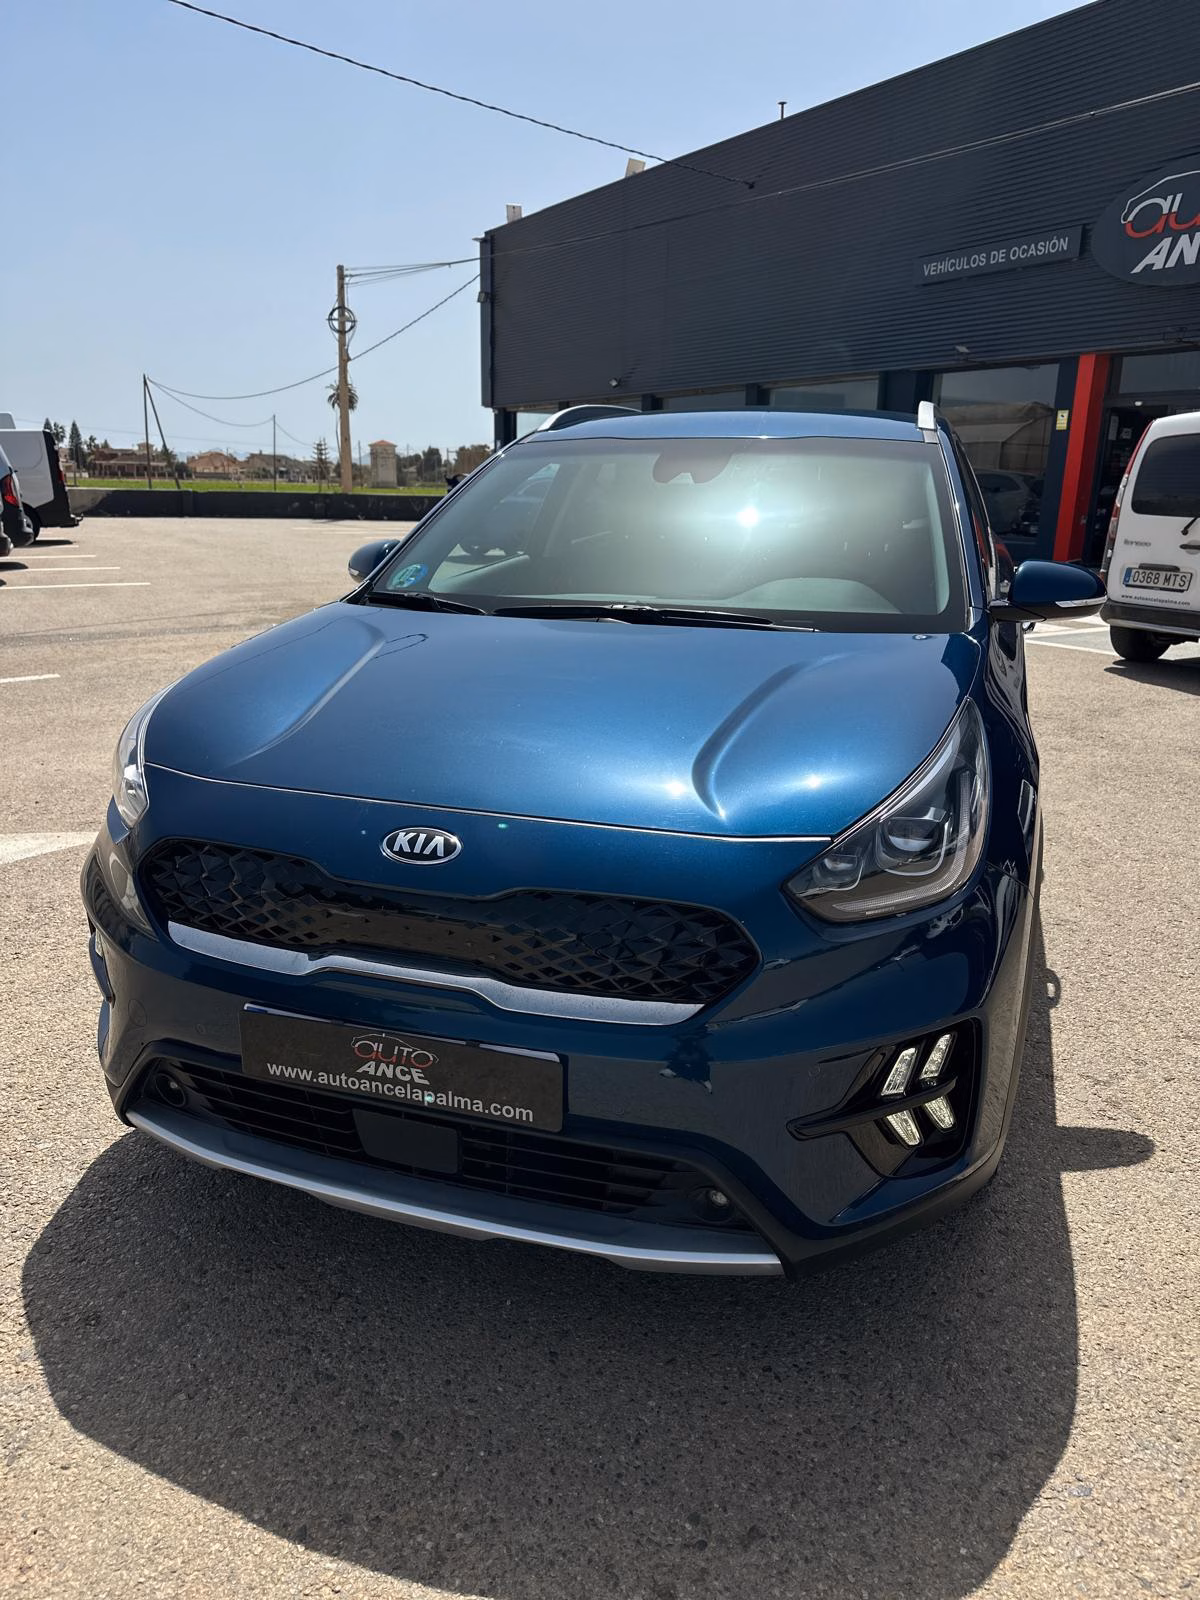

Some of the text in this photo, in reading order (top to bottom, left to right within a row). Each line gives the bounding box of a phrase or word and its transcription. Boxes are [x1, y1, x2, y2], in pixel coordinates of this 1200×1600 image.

[923, 236, 1069, 277] VEHÍCULOS DE OCASIÓN
[1132, 570, 1188, 588] 0368 MTS
[392, 832, 445, 857] KIA
[356, 1060, 430, 1085] ANCE
[266, 1063, 534, 1122] www.autoancelapalma.com
